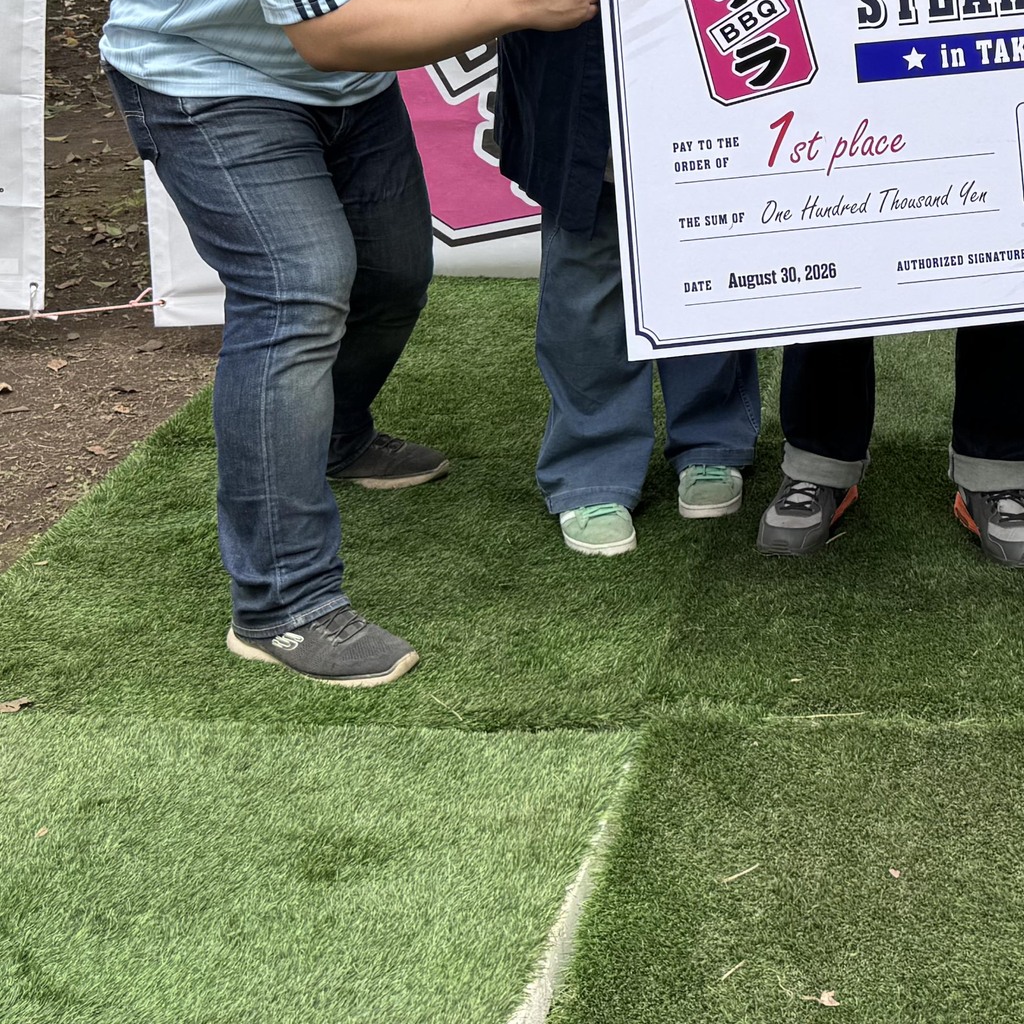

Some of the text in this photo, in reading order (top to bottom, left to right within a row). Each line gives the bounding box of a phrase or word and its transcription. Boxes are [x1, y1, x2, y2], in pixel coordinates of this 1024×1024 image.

[719, 0, 778, 44] BBQ
[940, 44, 966, 68] in
[673, 136, 740, 153] PAY TO THE
[768, 110, 906, 176] 1st place
[674, 157, 730, 173] ORDER OF
[761, 180, 988, 224] One Hundred Thousand Yen
[678, 212, 745, 229] THE SUM OF
[897, 254, 964, 272] AUTHORIZED
[684, 279, 712, 293] DATE
[728, 262, 837, 290] August 30, 2026
